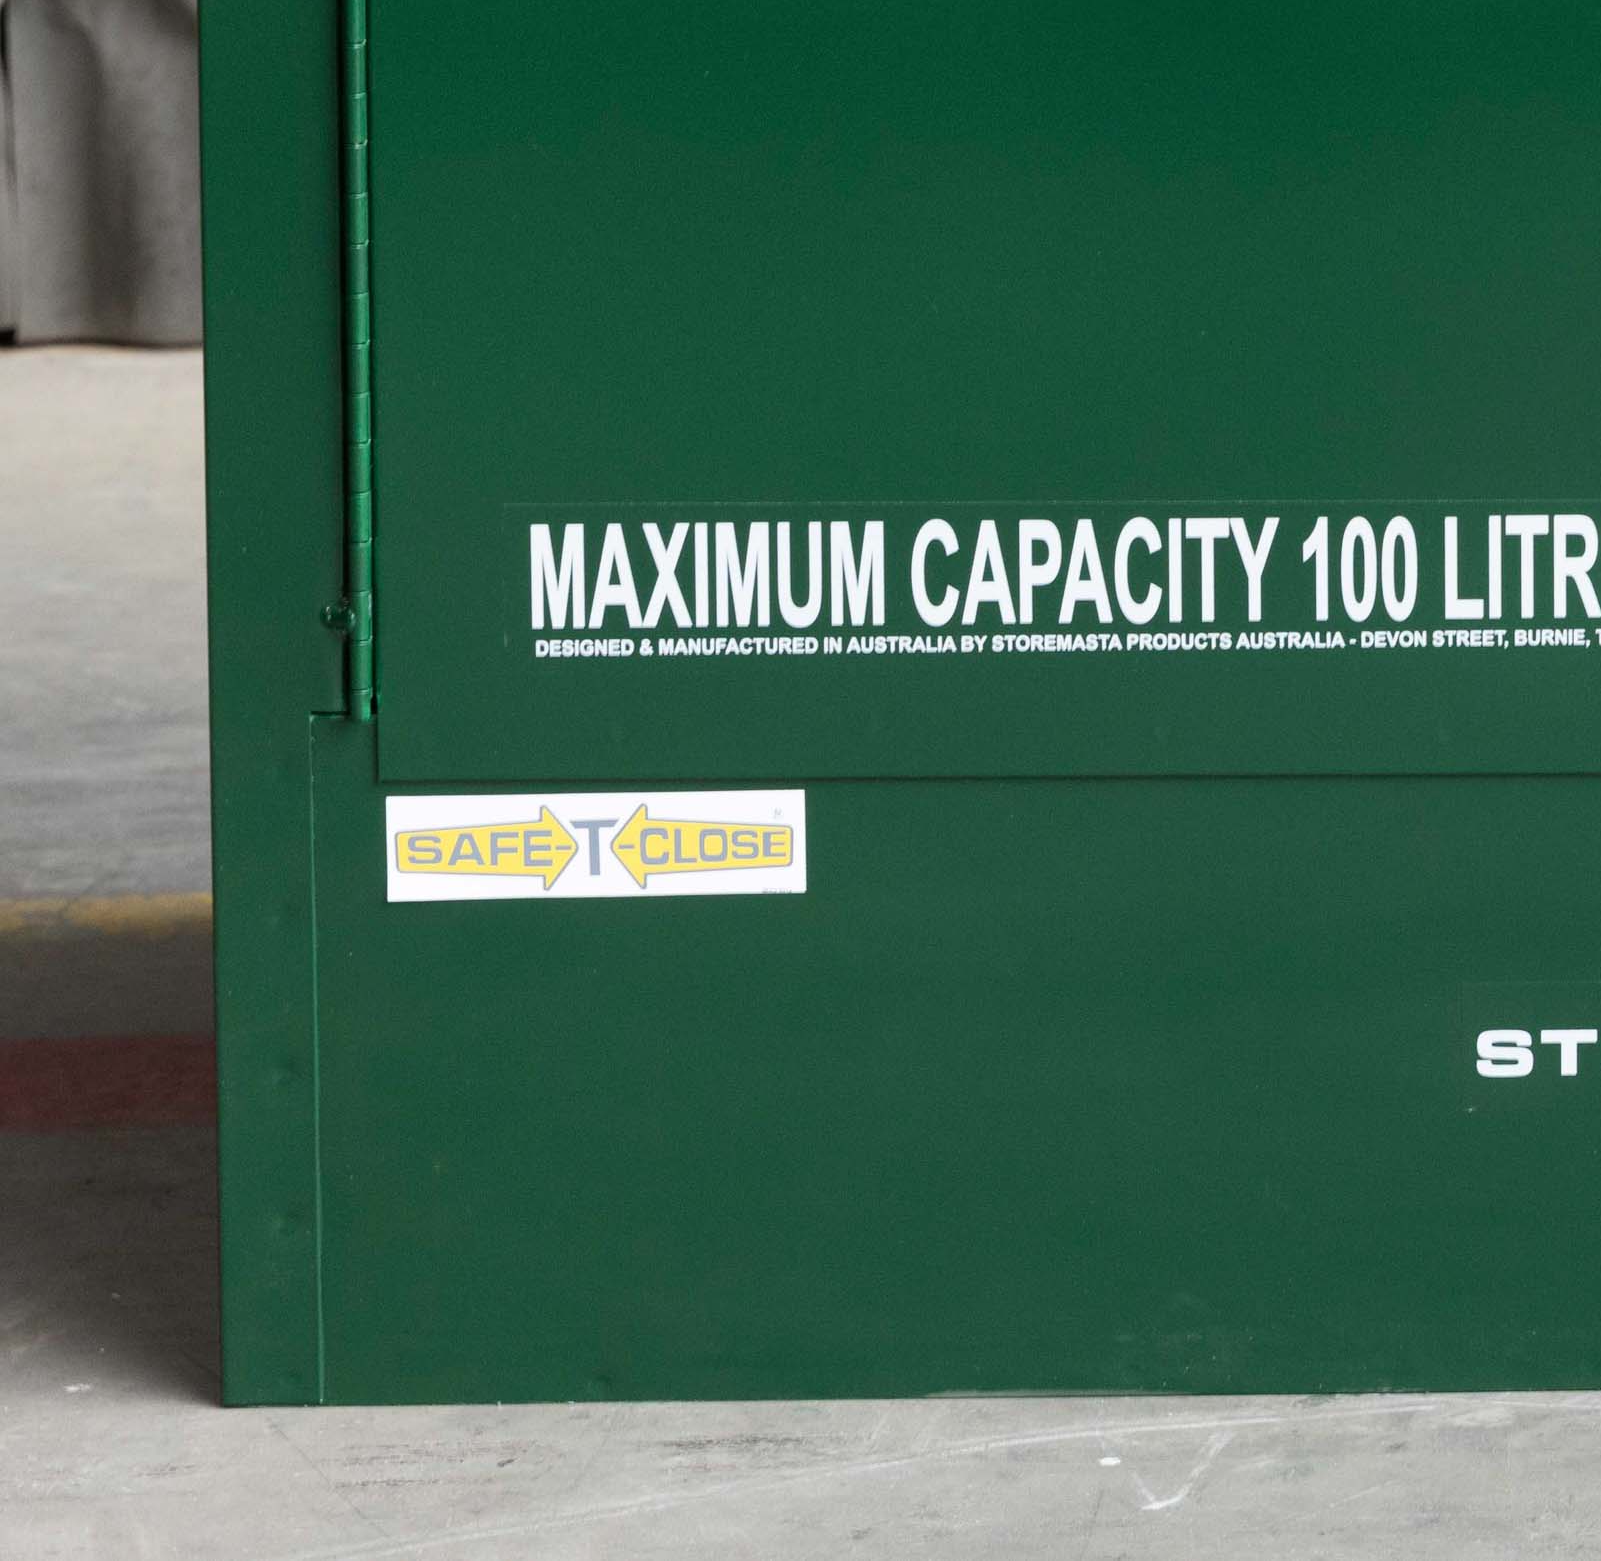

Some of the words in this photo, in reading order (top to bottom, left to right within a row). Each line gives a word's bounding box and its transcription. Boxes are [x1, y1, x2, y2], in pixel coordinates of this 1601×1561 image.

[530, 520, 885, 629] MAXIMUM
[911, 516, 1280, 626] CAPACITY
[1302, 516, 1417, 622] 100
[535, 638, 634, 657] DESIGNED
[639, 638, 654, 656] &
[658, 636, 818, 656] MANUFACTURED
[823, 636, 842, 654] IN
[846, 635, 957, 654] AUSTRALIA
[960, 635, 987, 653] BY
[991, 633, 1123, 652] STOREMASTA
[1126, 632, 1232, 651] PRODUCTS
[1235, 631, 1346, 649] AUSTRALIA
[1360, 630, 1427, 648] DEVON
[1432, 629, 1509, 649] STREET,
[1514, 628, 1590, 648] BURNIE,
